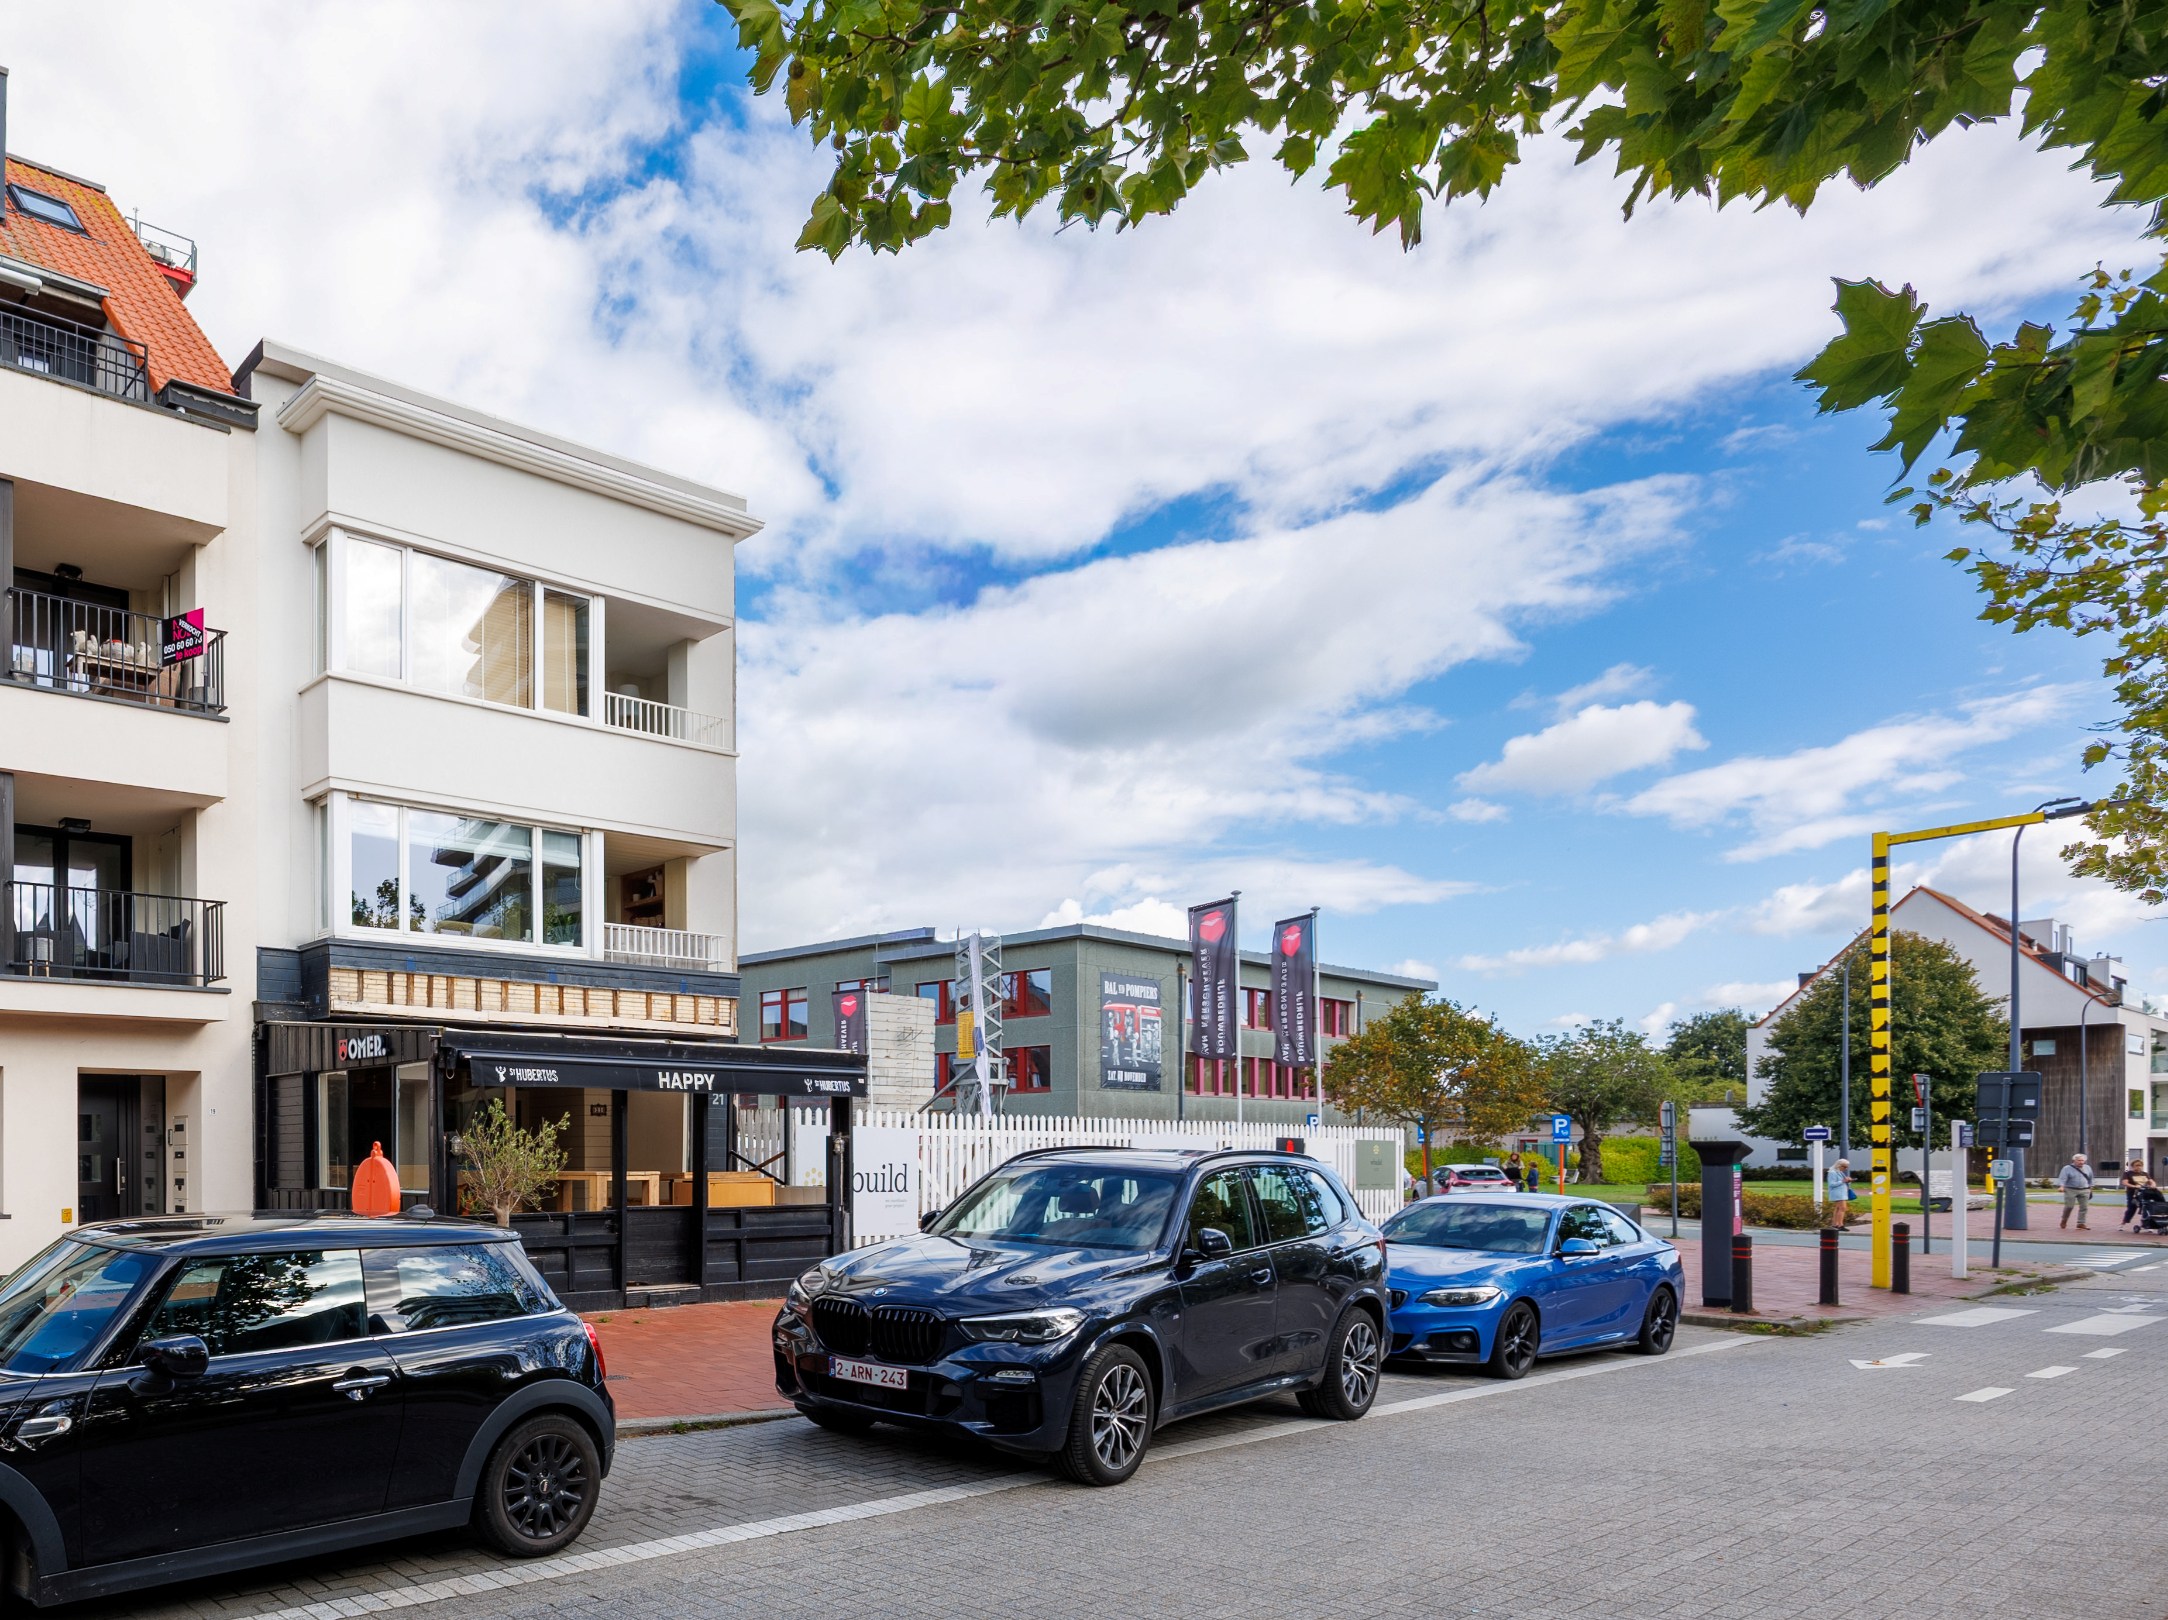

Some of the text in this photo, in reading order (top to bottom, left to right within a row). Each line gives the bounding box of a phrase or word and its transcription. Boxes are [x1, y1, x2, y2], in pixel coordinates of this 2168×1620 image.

[164, 643, 175, 654] 050
[176, 640, 184, 650] 60
[185, 637, 193, 647] 60
[184, 645, 202, 657] koop
[1104, 980, 1118, 995] BAL
[1125, 983, 1158, 1000] POMPIERS
[348, 1034, 387, 1059] OMER.
[515, 1067, 559, 1083] HUBERTUS
[657, 1071, 715, 1091] HAPPY
[712, 1093, 724, 1105] 21
[1555, 1118, 1568, 1134] P
[836, 1361, 905, 1387] 2-ARN-243
